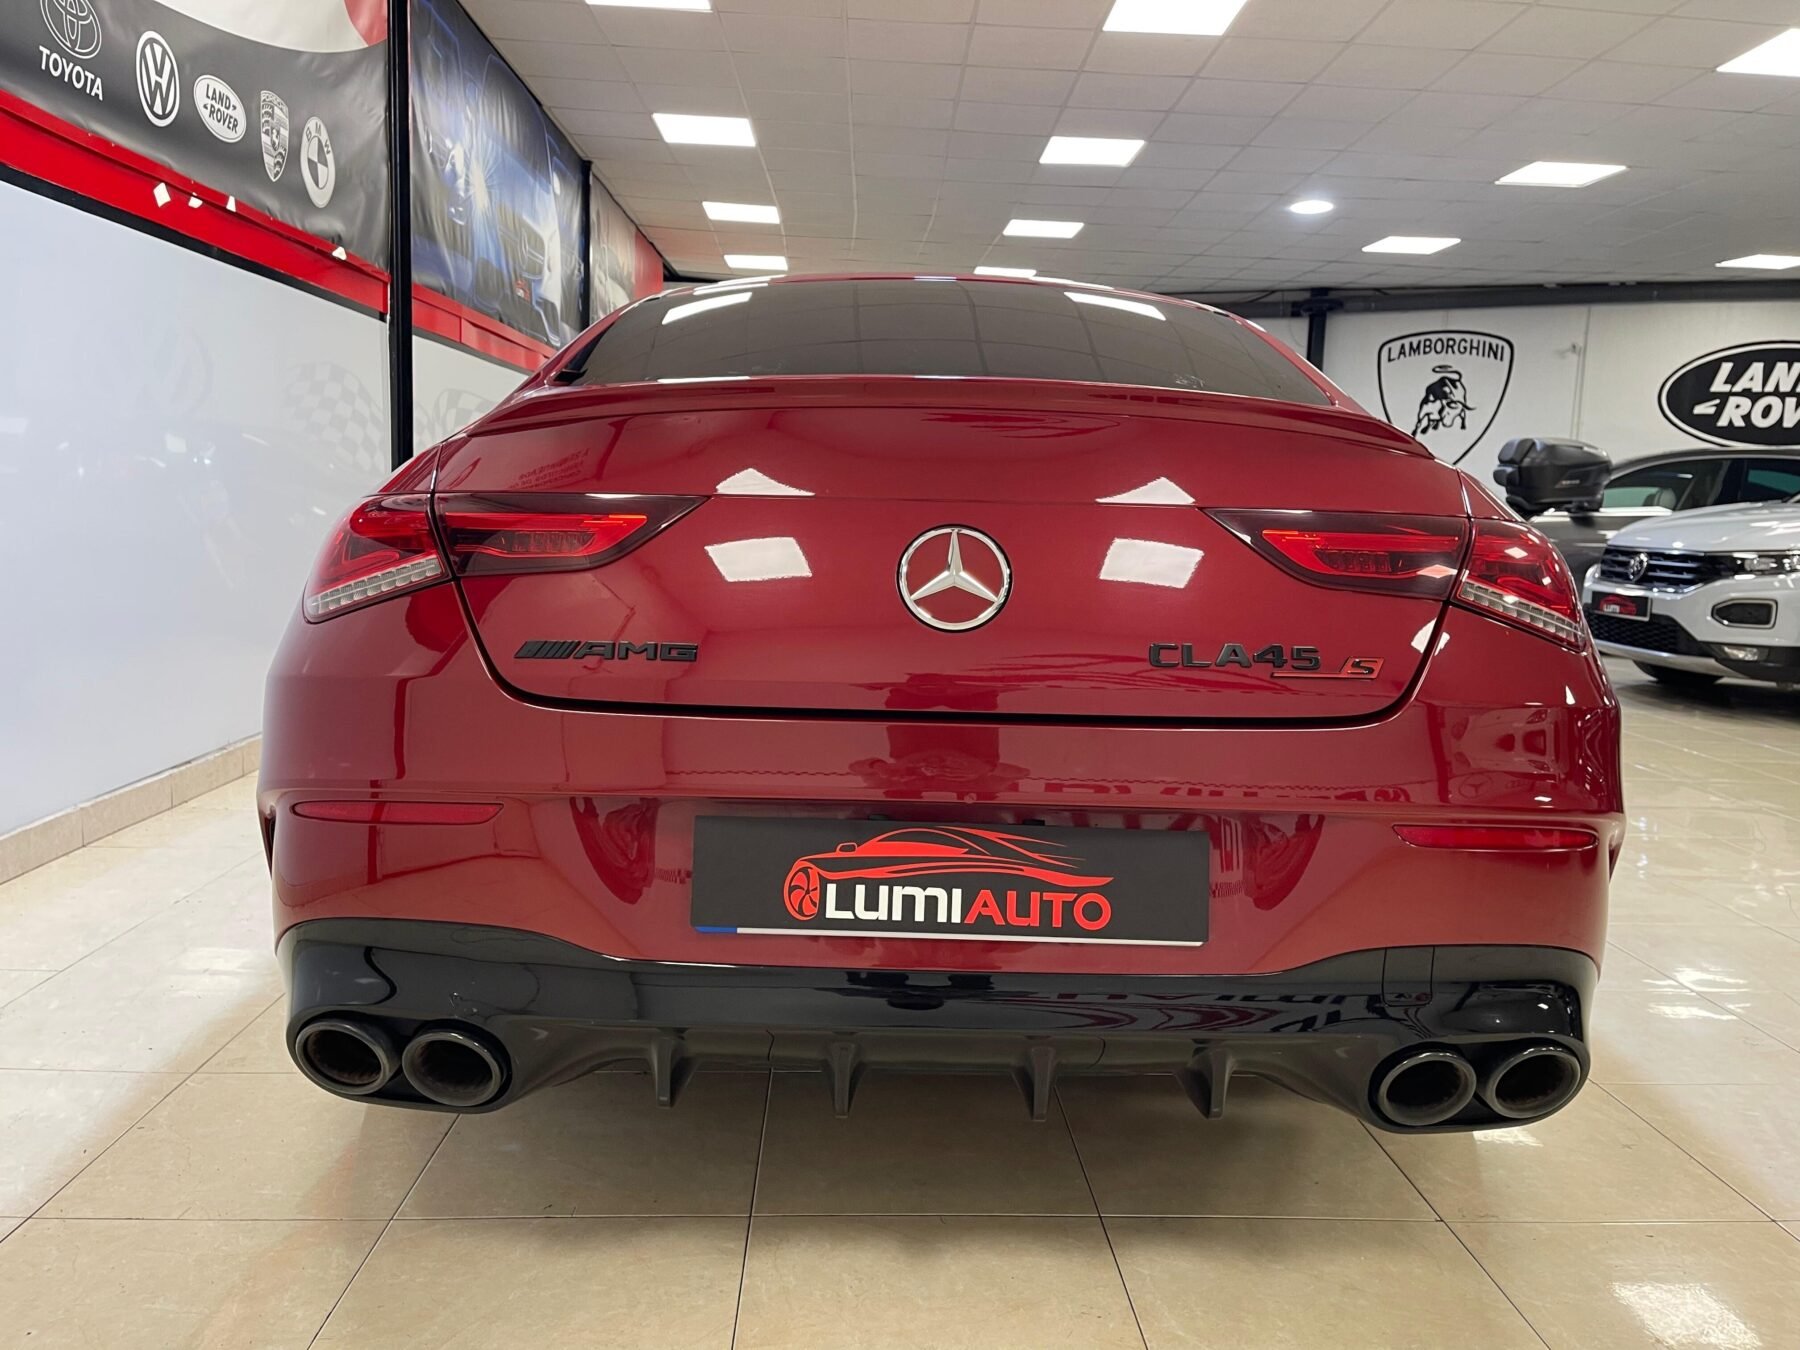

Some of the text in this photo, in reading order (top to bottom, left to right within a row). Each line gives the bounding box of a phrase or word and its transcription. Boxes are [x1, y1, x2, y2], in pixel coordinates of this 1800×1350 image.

[39, 45, 103, 101] TOYOTA
[205, 84, 233, 111] LAND
[208, 104, 239, 134] ROVER
[305, 121, 331, 155] BMW
[1387, 338, 1505, 362] LAMBORGHINI
[1709, 361, 1800, 393] LAN
[573, 640, 699, 662] AMG
[1149, 643, 1379, 676] CLA45 S
